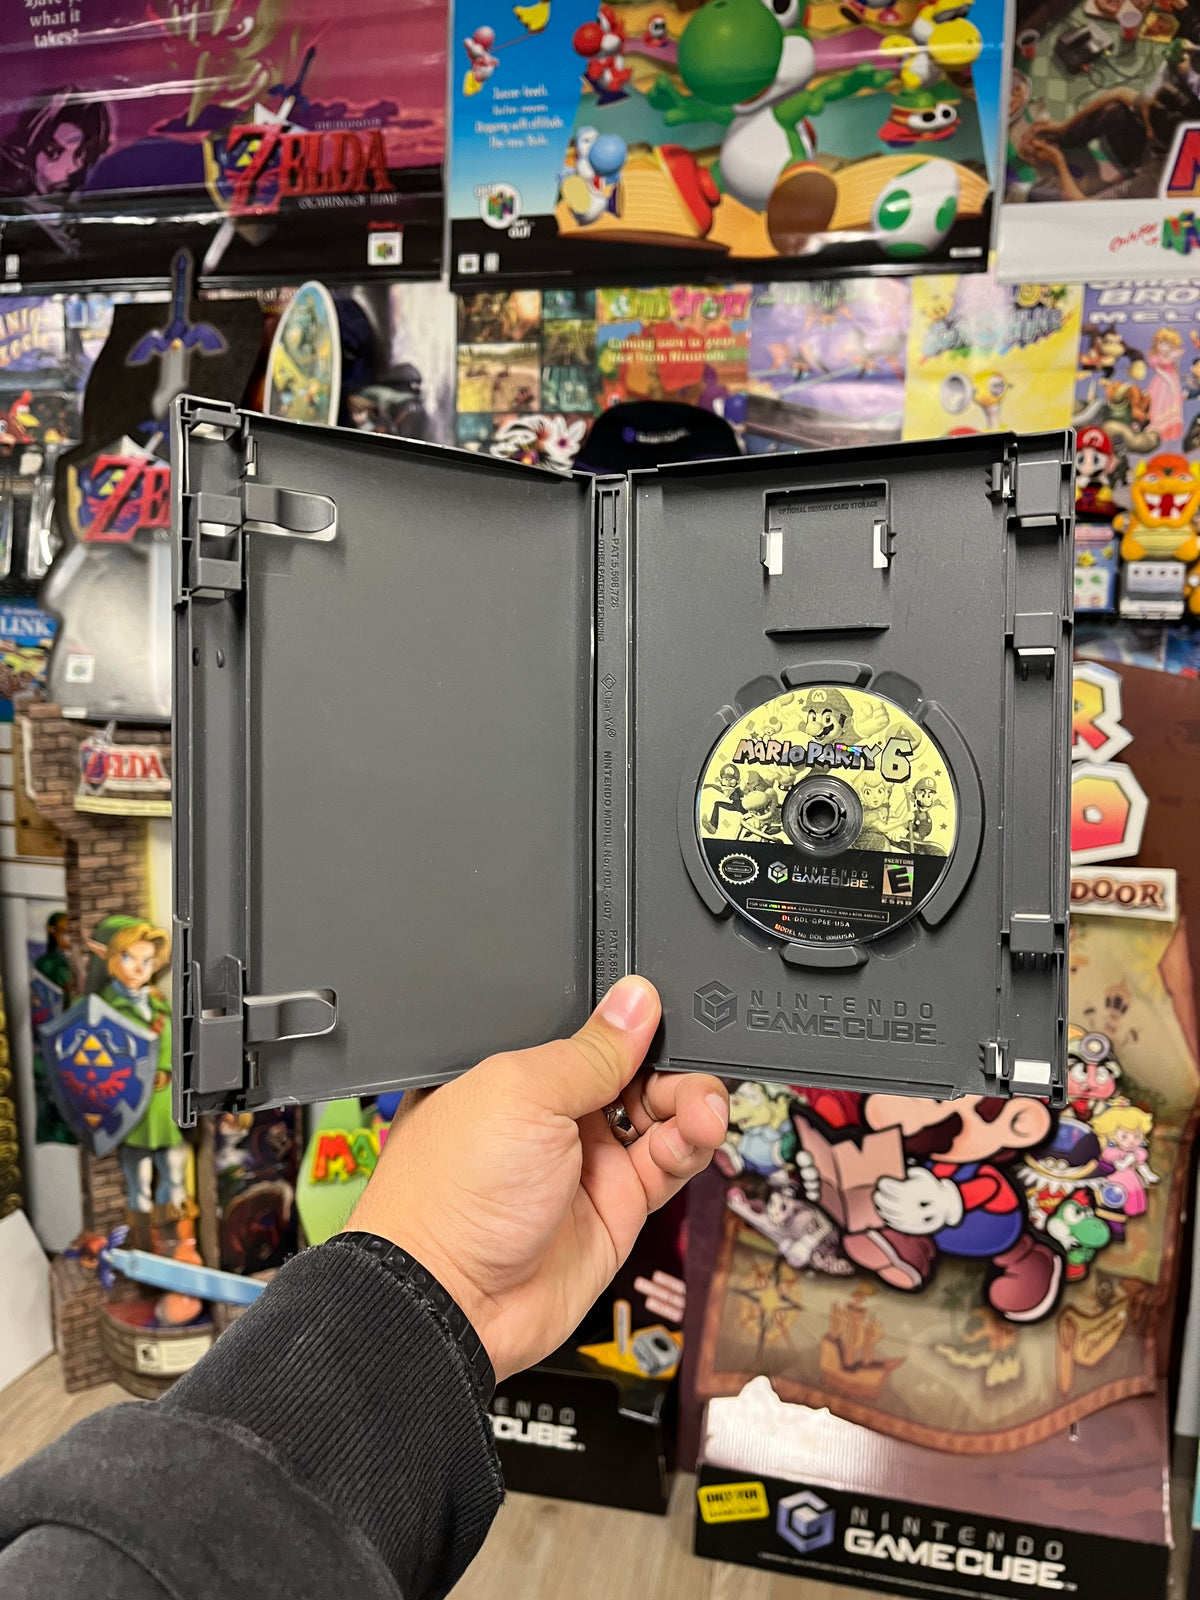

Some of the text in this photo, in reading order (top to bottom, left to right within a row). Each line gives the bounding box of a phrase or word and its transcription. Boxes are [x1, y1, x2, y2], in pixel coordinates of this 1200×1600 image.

[30, 8, 81, 27] what it
[34, 28, 79, 48] takes?
[225, 124, 397, 216] ZELDA
[1089, 309, 1200, 324] MEL
[778, 500, 878, 515] OPTIONAL MEMORY CARD STORAGE
[603, 750, 613, 807] NINTENDO
[732, 737, 914, 784] MARIO PARTY 6
[603, 809, 613, 848] MODEL
[793, 864, 868, 879] NINTENDO
[1070, 875, 1165, 911] DOOR
[774, 923, 796, 936] MODEL
[750, 989, 935, 1021] NINTENDO
[746, 1009, 938, 1046] GAMECUBE
[850, 1505, 1064, 1561] NINTENDO
[843, 1526, 1067, 1591] GAMECUBE
